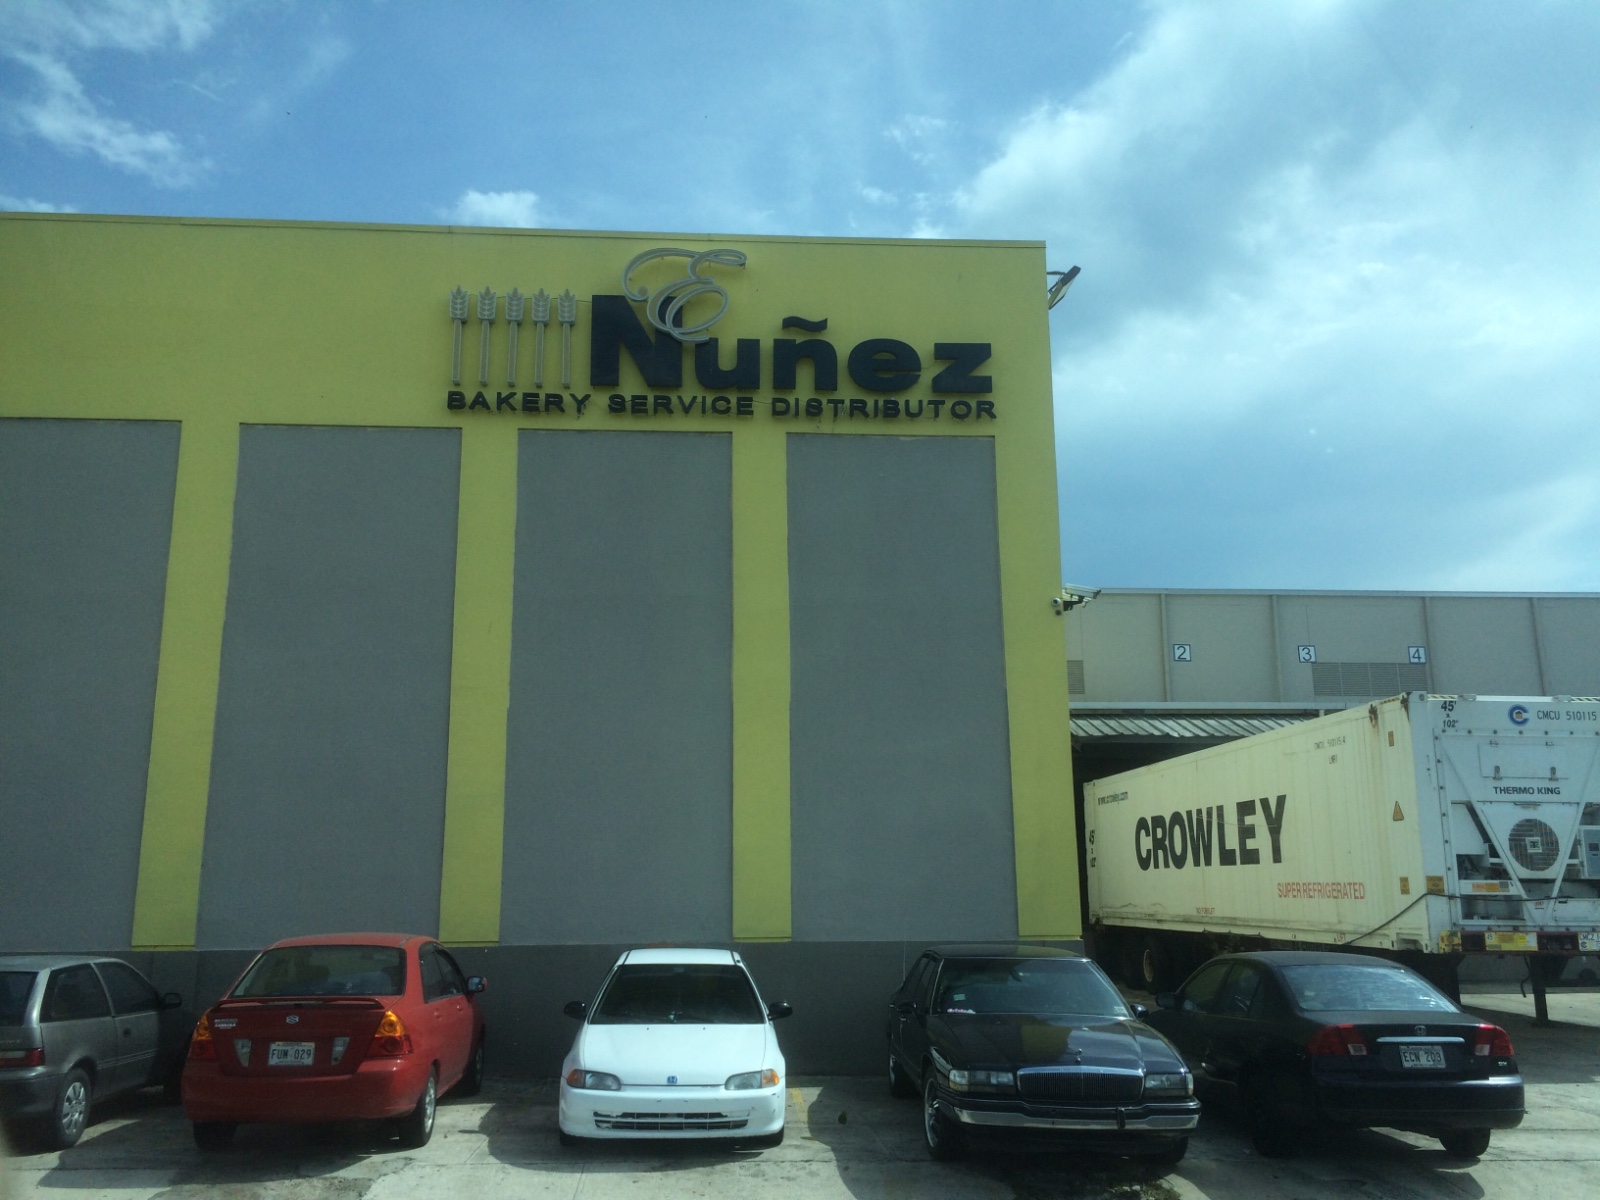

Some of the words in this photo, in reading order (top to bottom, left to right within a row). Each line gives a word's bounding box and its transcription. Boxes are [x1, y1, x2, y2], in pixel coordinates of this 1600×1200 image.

[590, 294, 993, 394] Nuñez
[447, 390, 592, 415] BAKERY
[607, 393, 754, 417] SERVICE
[771, 396, 997, 421] DISTRIBUTOR
[1176, 646, 1187, 660] 2
[1302, 647, 1312, 661] 3
[1412, 648, 1422, 662] 4
[1536, 710, 1561, 721] CMCU
[1566, 710, 1597, 721] 510115
[1492, 786, 1535, 795] THERMO
[1536, 786, 1561, 795] KING
[1135, 794, 1287, 871] CROWLEY
[294, 1048, 312, 1060] 029
[1402, 1051, 1421, 1063] ECN
[1424, 1051, 1442, 1063] 203
